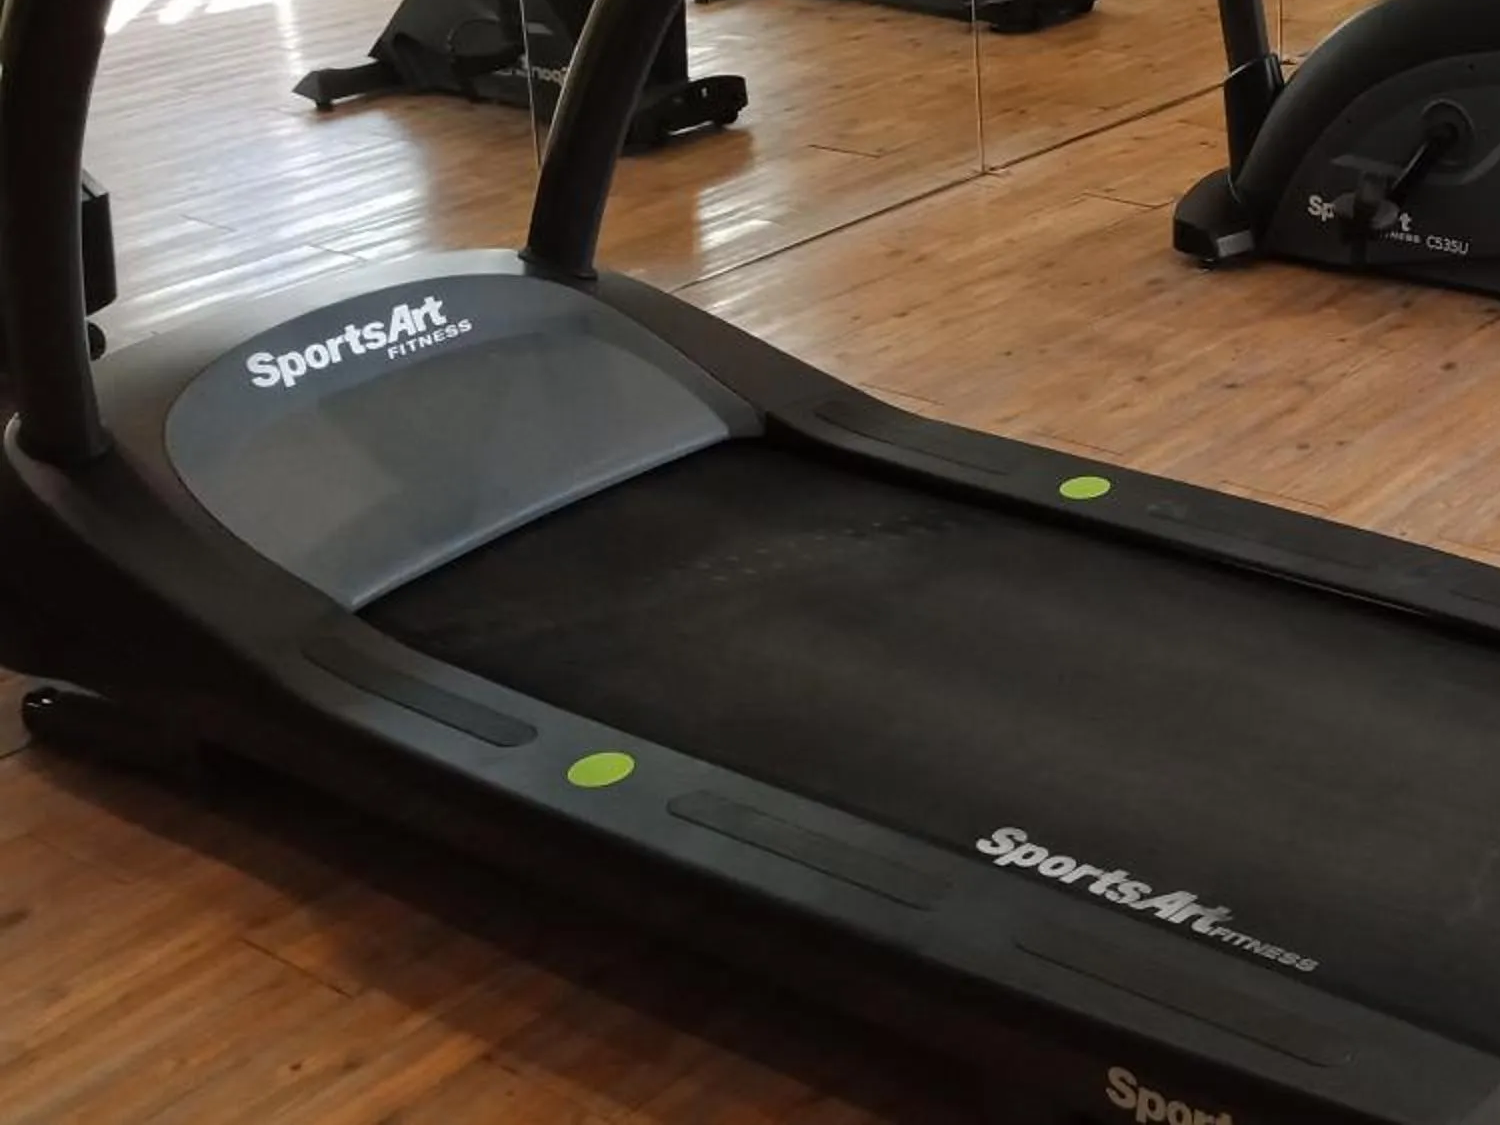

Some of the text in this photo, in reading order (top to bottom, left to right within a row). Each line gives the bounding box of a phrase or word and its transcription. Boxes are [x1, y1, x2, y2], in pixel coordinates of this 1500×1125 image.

[1425, 235, 1469, 255] C535U
[246, 296, 447, 388] SportsArt
[387, 318, 473, 360] FITNESS
[975, 826, 1320, 973] SportsArt FITNESS
